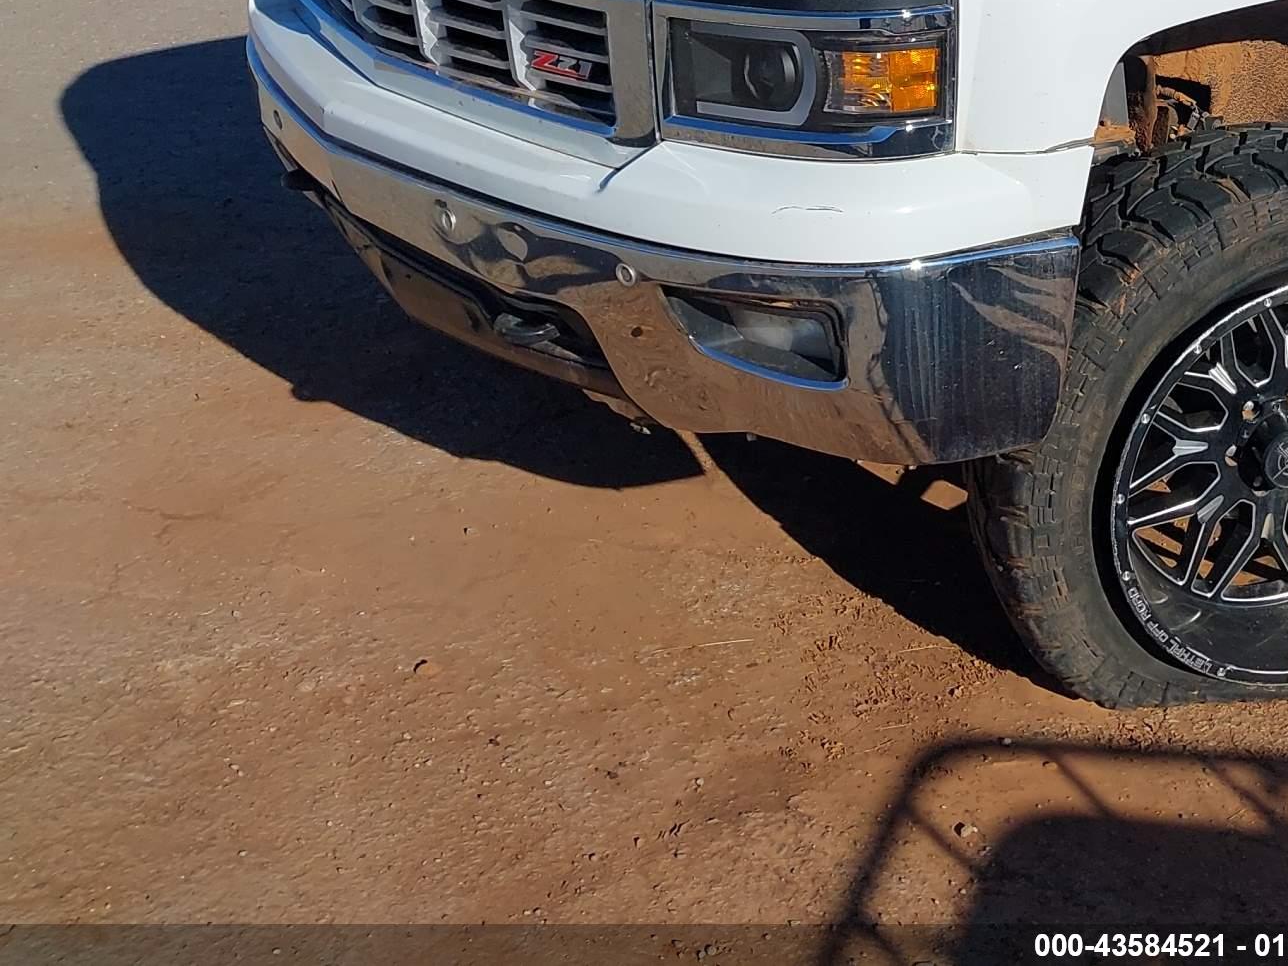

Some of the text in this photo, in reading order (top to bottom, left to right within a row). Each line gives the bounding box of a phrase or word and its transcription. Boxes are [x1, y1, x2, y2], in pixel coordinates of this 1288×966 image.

[530, 49, 593, 81] Z71
[1127, 586, 1212, 674] LETHAL OFF ROAD
